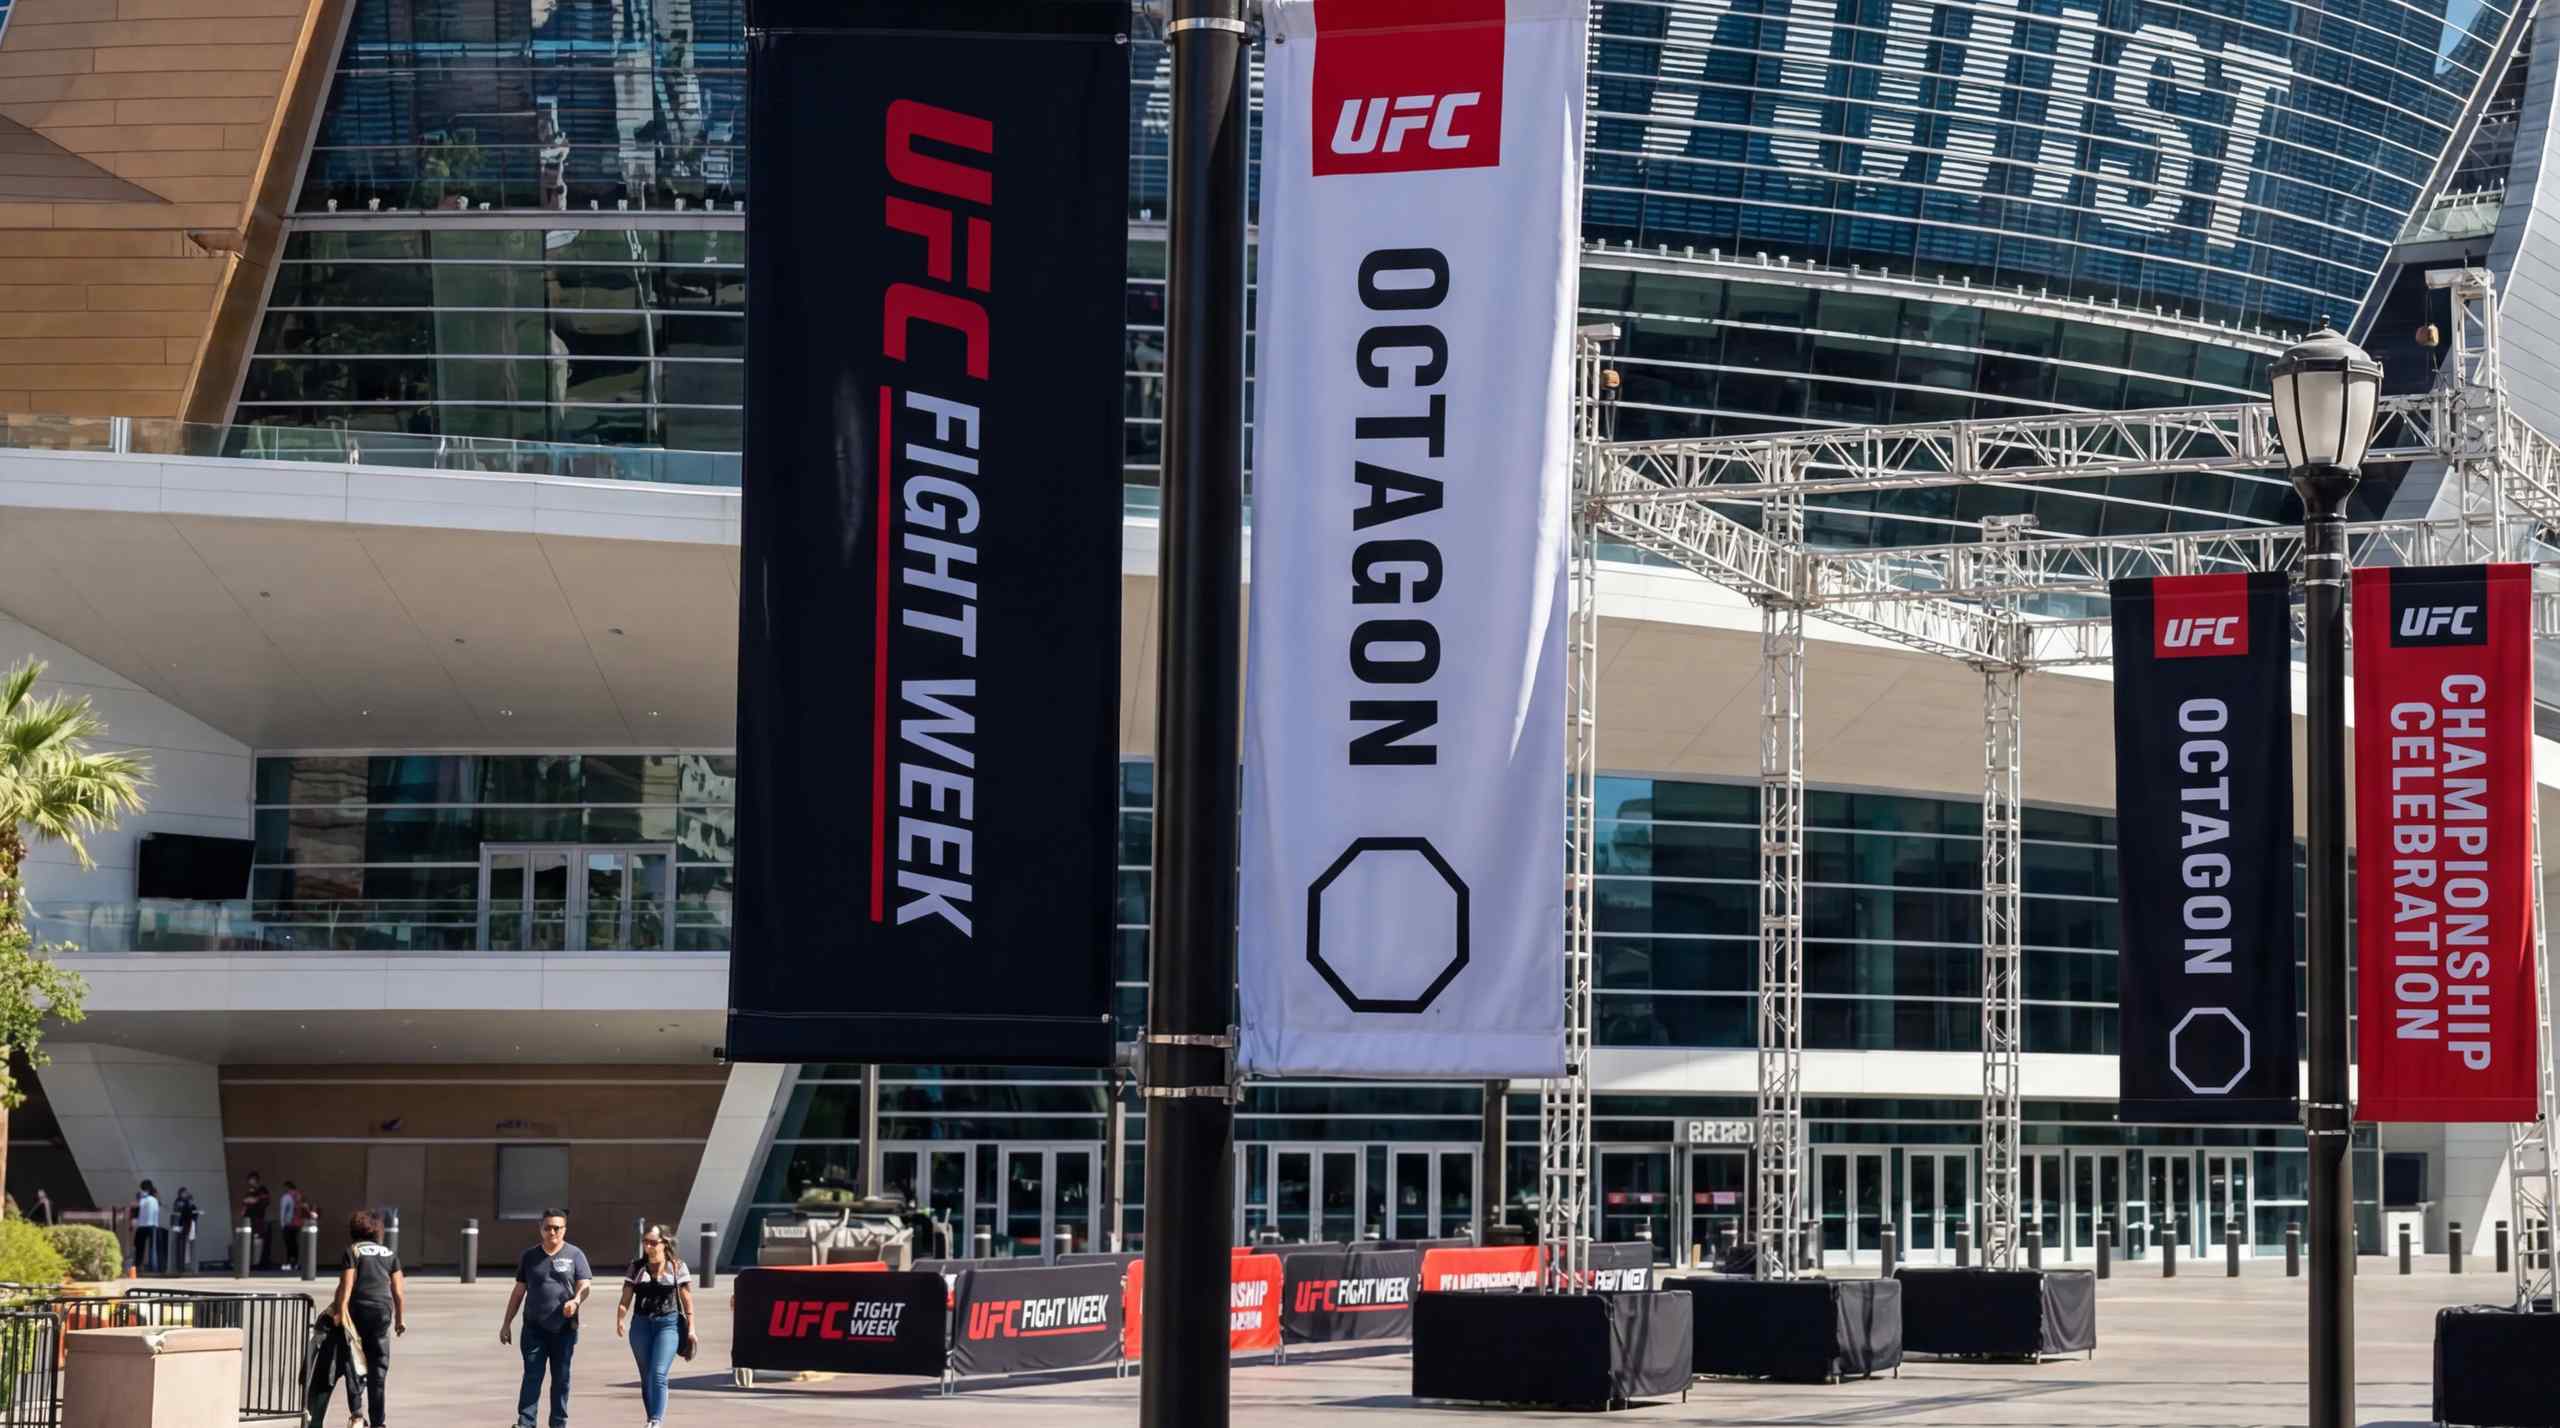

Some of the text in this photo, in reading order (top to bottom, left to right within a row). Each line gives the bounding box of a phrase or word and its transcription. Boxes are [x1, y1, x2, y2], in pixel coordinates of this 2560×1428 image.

[1331, 92, 1480, 154] UFC
[884, 100, 992, 937] UFC FIGHT WEEK
[1350, 249, 1449, 765] OCTAGON
[2164, 617, 2239, 647] UFC
[2400, 606, 2477, 636] UFC
[2179, 699, 2232, 973] OCTAGON
[2391, 703, 2439, 1039] CELEBRATION
[2440, 674, 2491, 1070] CHAMPIONSHIP
[768, 1300, 905, 1339] UFC FIGHT
[968, 1294, 1109, 1340] UFC FIGHT WEEK
[1294, 1279, 1337, 1313] UFC
[1338, 1278, 1373, 1305] FIGHT
[1373, 1277, 1410, 1303] WEEK
[850, 1319, 900, 1337] WEEK
